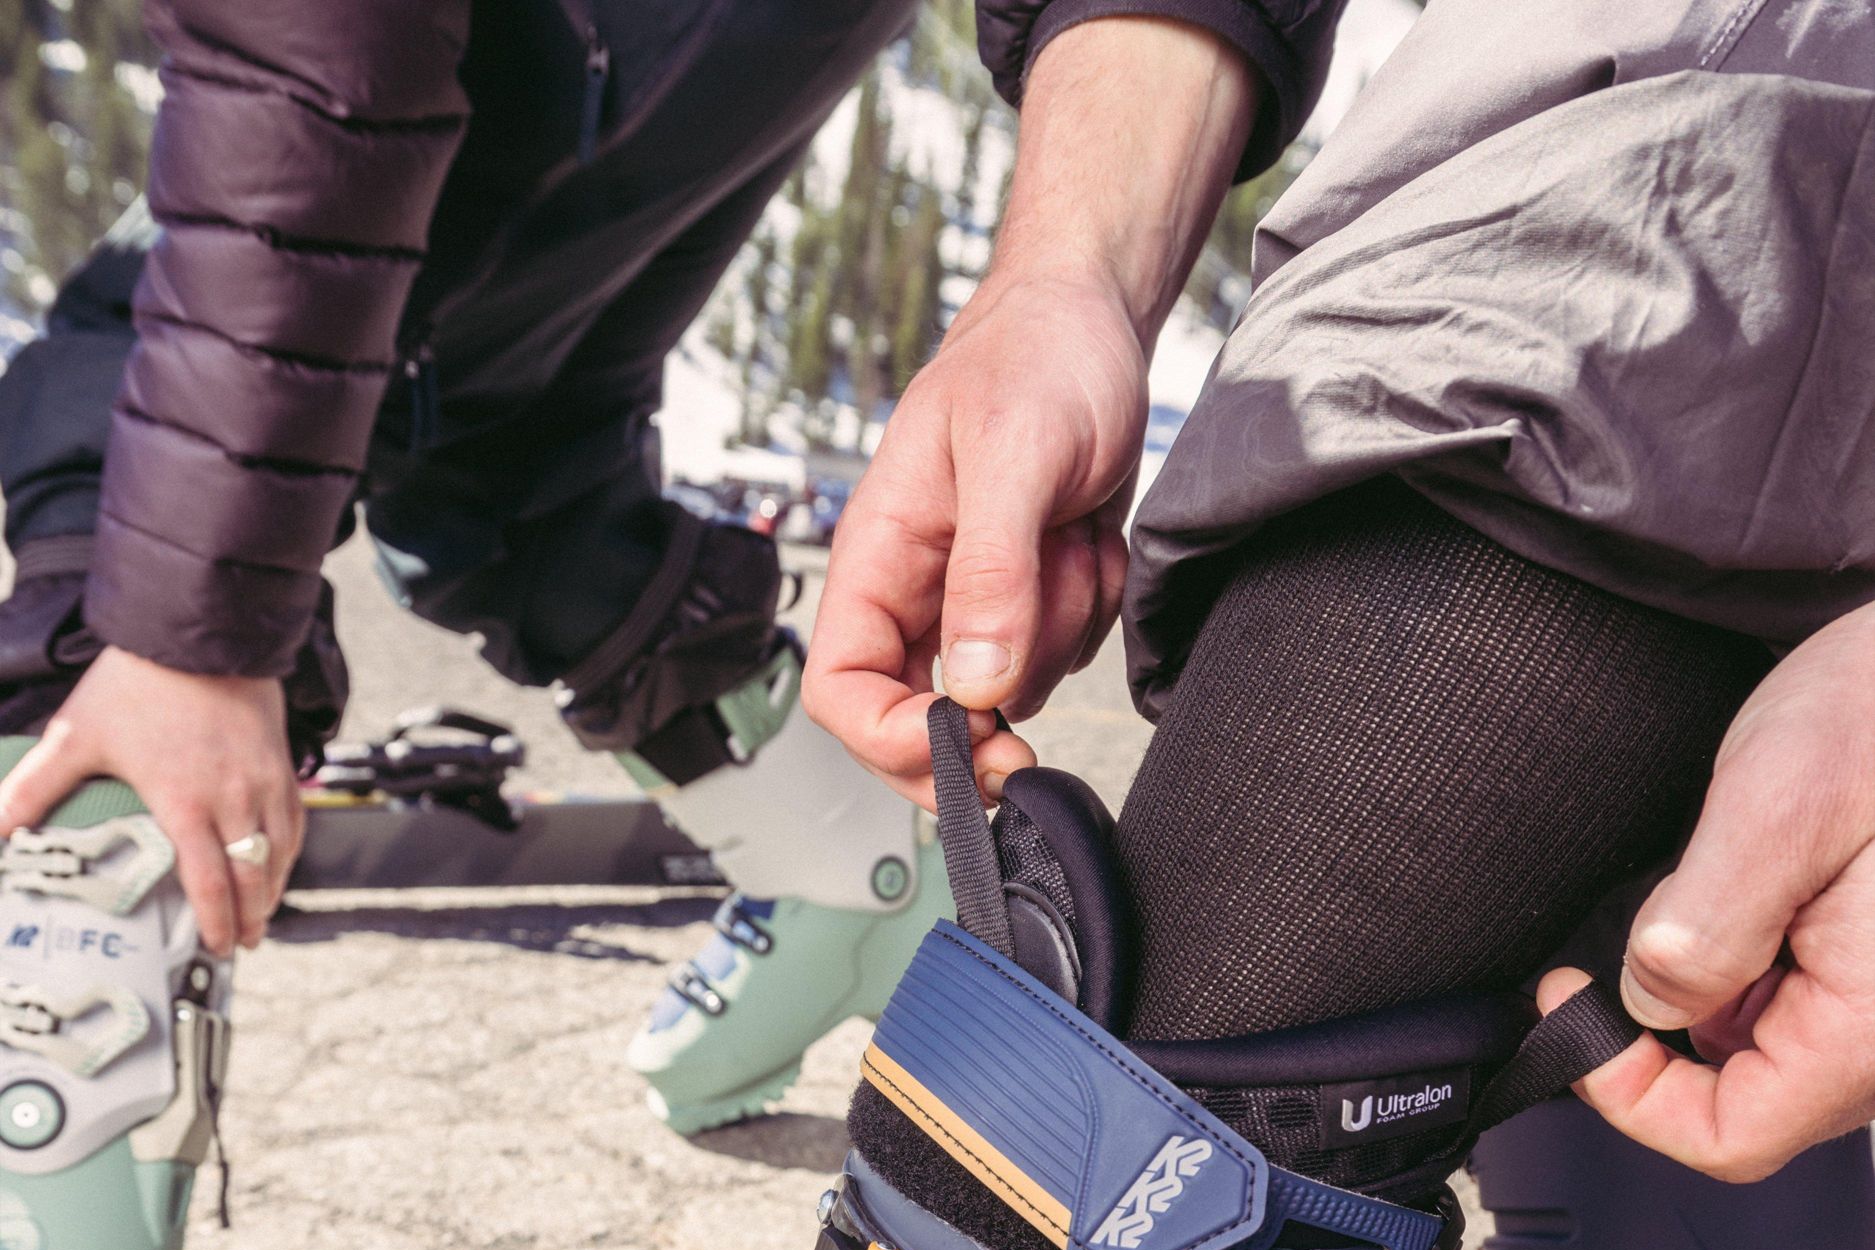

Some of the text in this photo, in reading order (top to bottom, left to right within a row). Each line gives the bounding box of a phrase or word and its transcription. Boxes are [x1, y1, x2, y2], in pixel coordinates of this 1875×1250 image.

[1376, 1102, 1440, 1124] FOAM GROUP
[1377, 1084, 1452, 1116] Ultralon
[1145, 1135, 1213, 1177] K2
[1117, 1171, 1184, 1213] K2
[1089, 1207, 1154, 1249] K2
